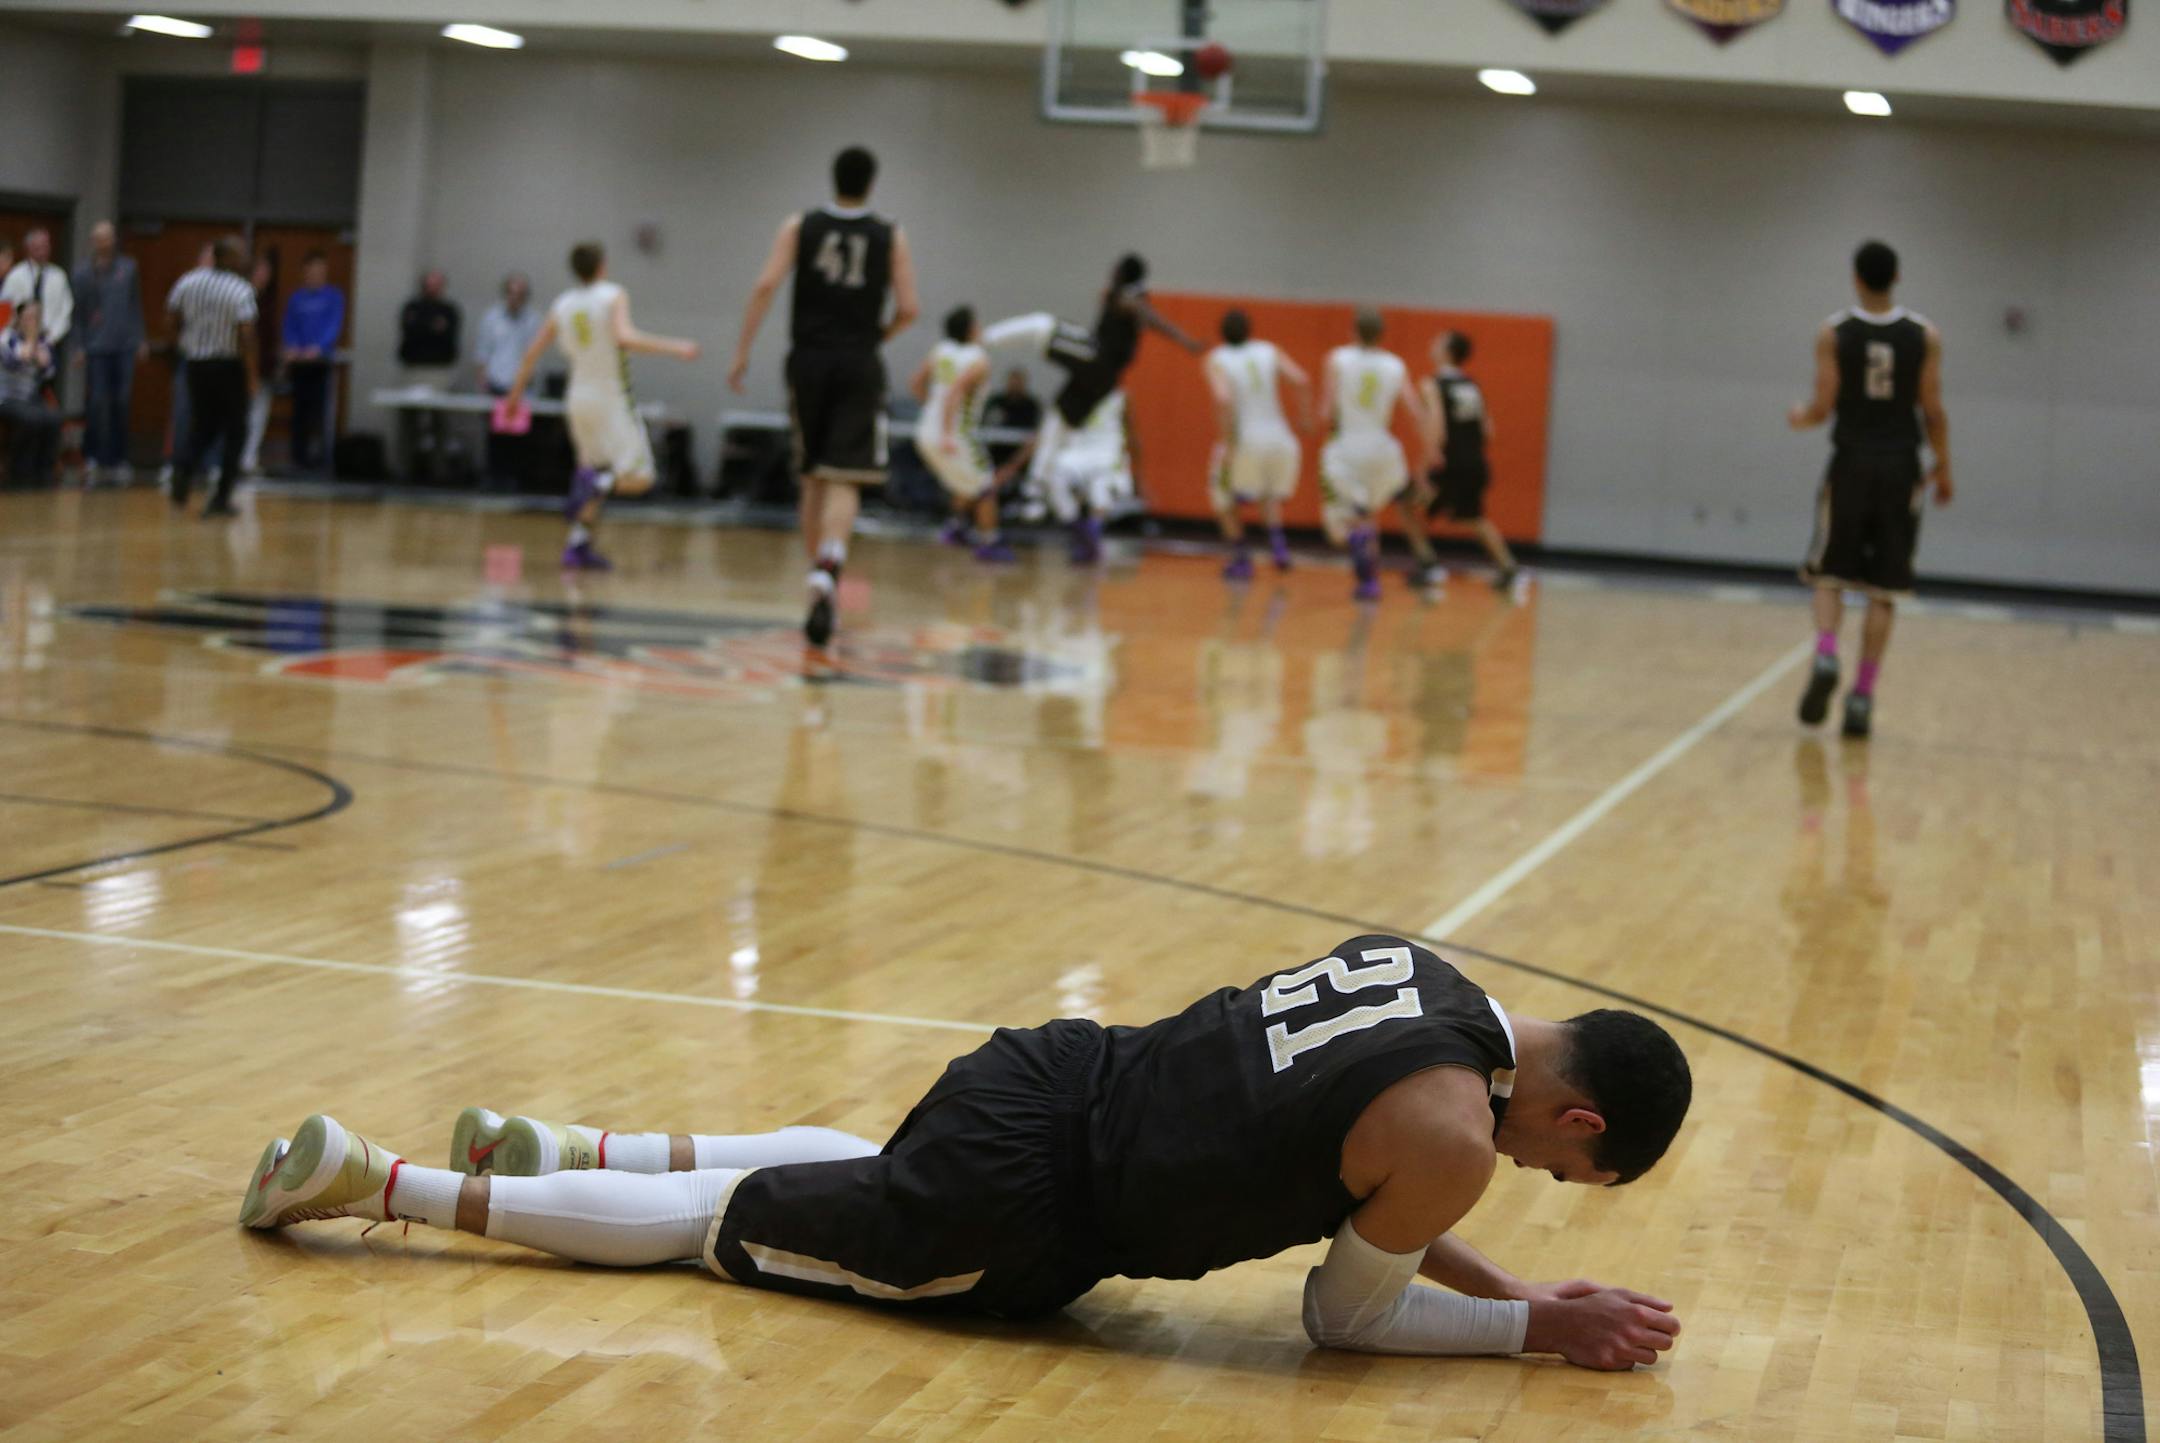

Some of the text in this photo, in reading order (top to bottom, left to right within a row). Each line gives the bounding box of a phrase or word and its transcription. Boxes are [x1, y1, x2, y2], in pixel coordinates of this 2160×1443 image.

[813, 231, 869, 288] 41
[1865, 342, 1895, 399] 2
[1261, 947, 1423, 1073] 21
